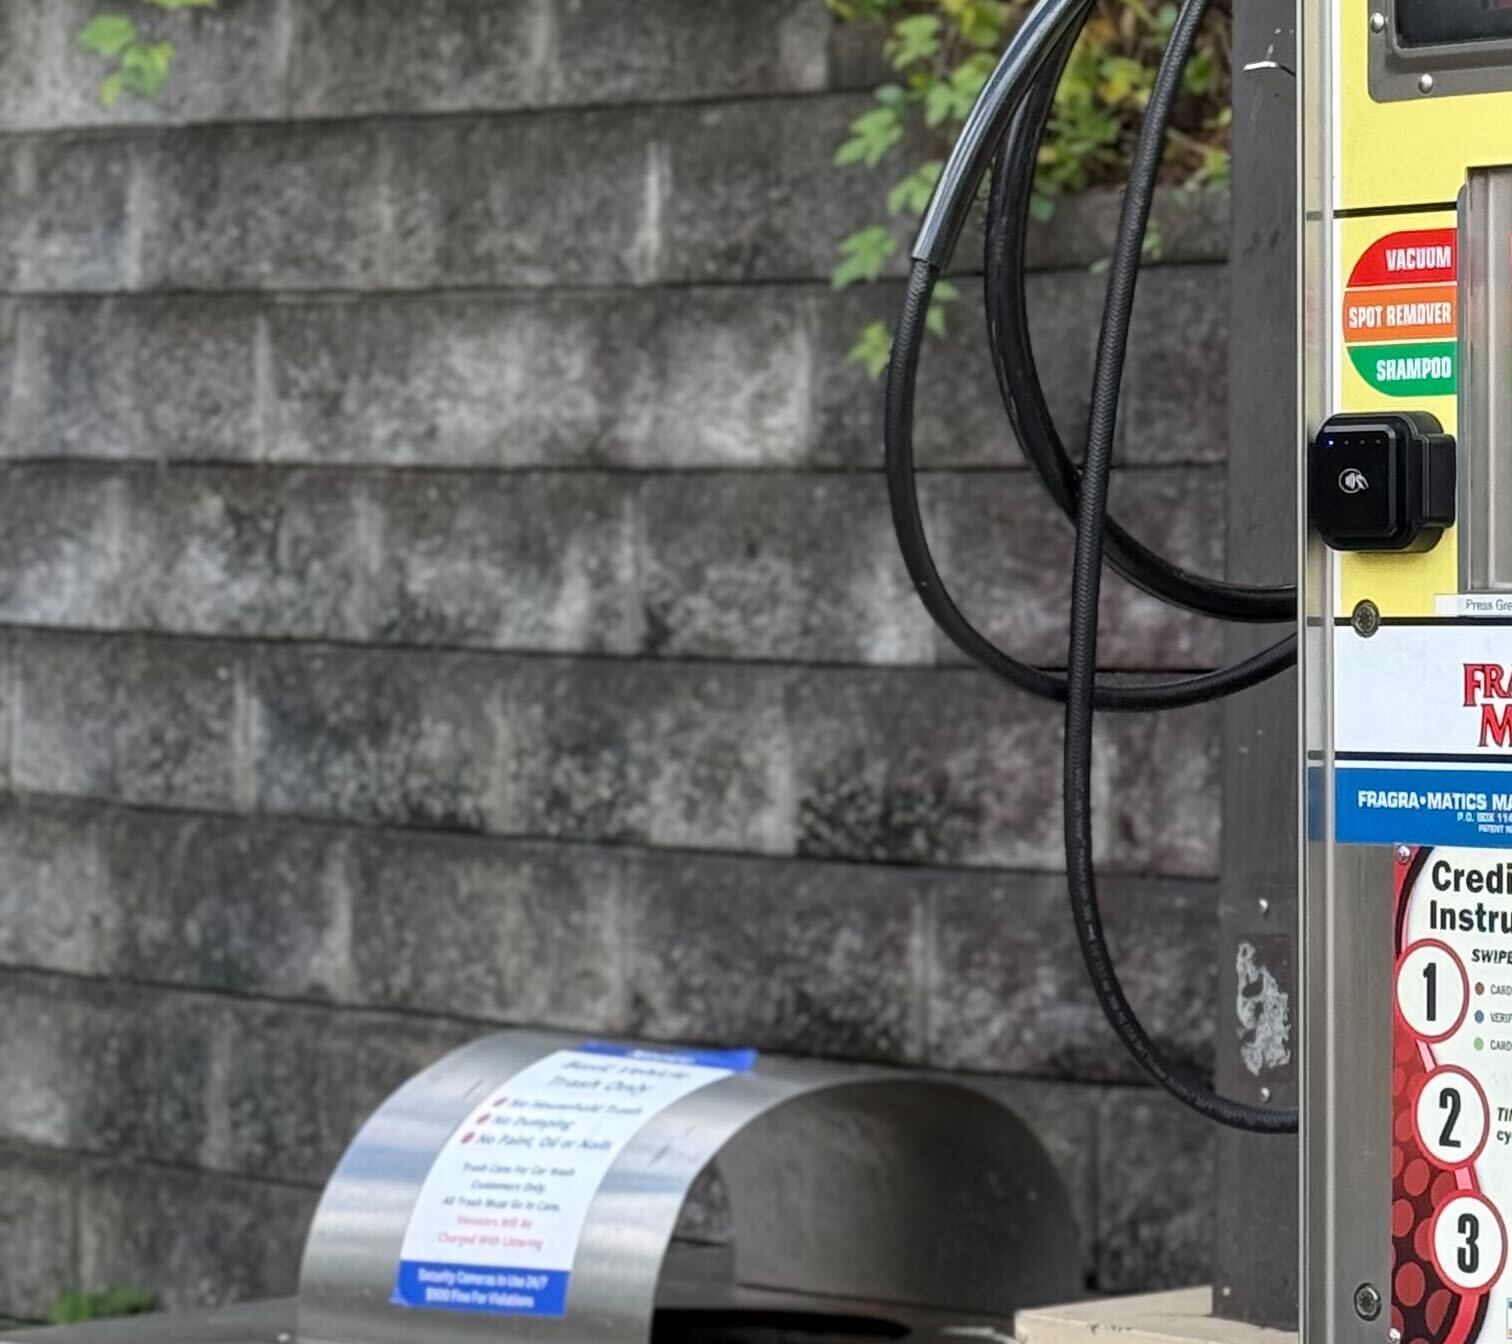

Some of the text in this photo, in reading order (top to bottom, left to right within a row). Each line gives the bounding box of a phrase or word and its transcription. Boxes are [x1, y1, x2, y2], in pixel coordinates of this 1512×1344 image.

[1386, 246, 1451, 272] VACUUM
[1349, 302, 1451, 328] SPOT REMOVER
[1376, 356, 1451, 381] SHAMPOO
[1466, 599, 1493, 611] Press
[1423, 962, 1436, 1021] 1
[1490, 984, 1512, 996] CARD
[1490, 1040, 1512, 1051] CARD
[1439, 1087, 1461, 1148] 2
[1457, 1213, 1479, 1274] 3
